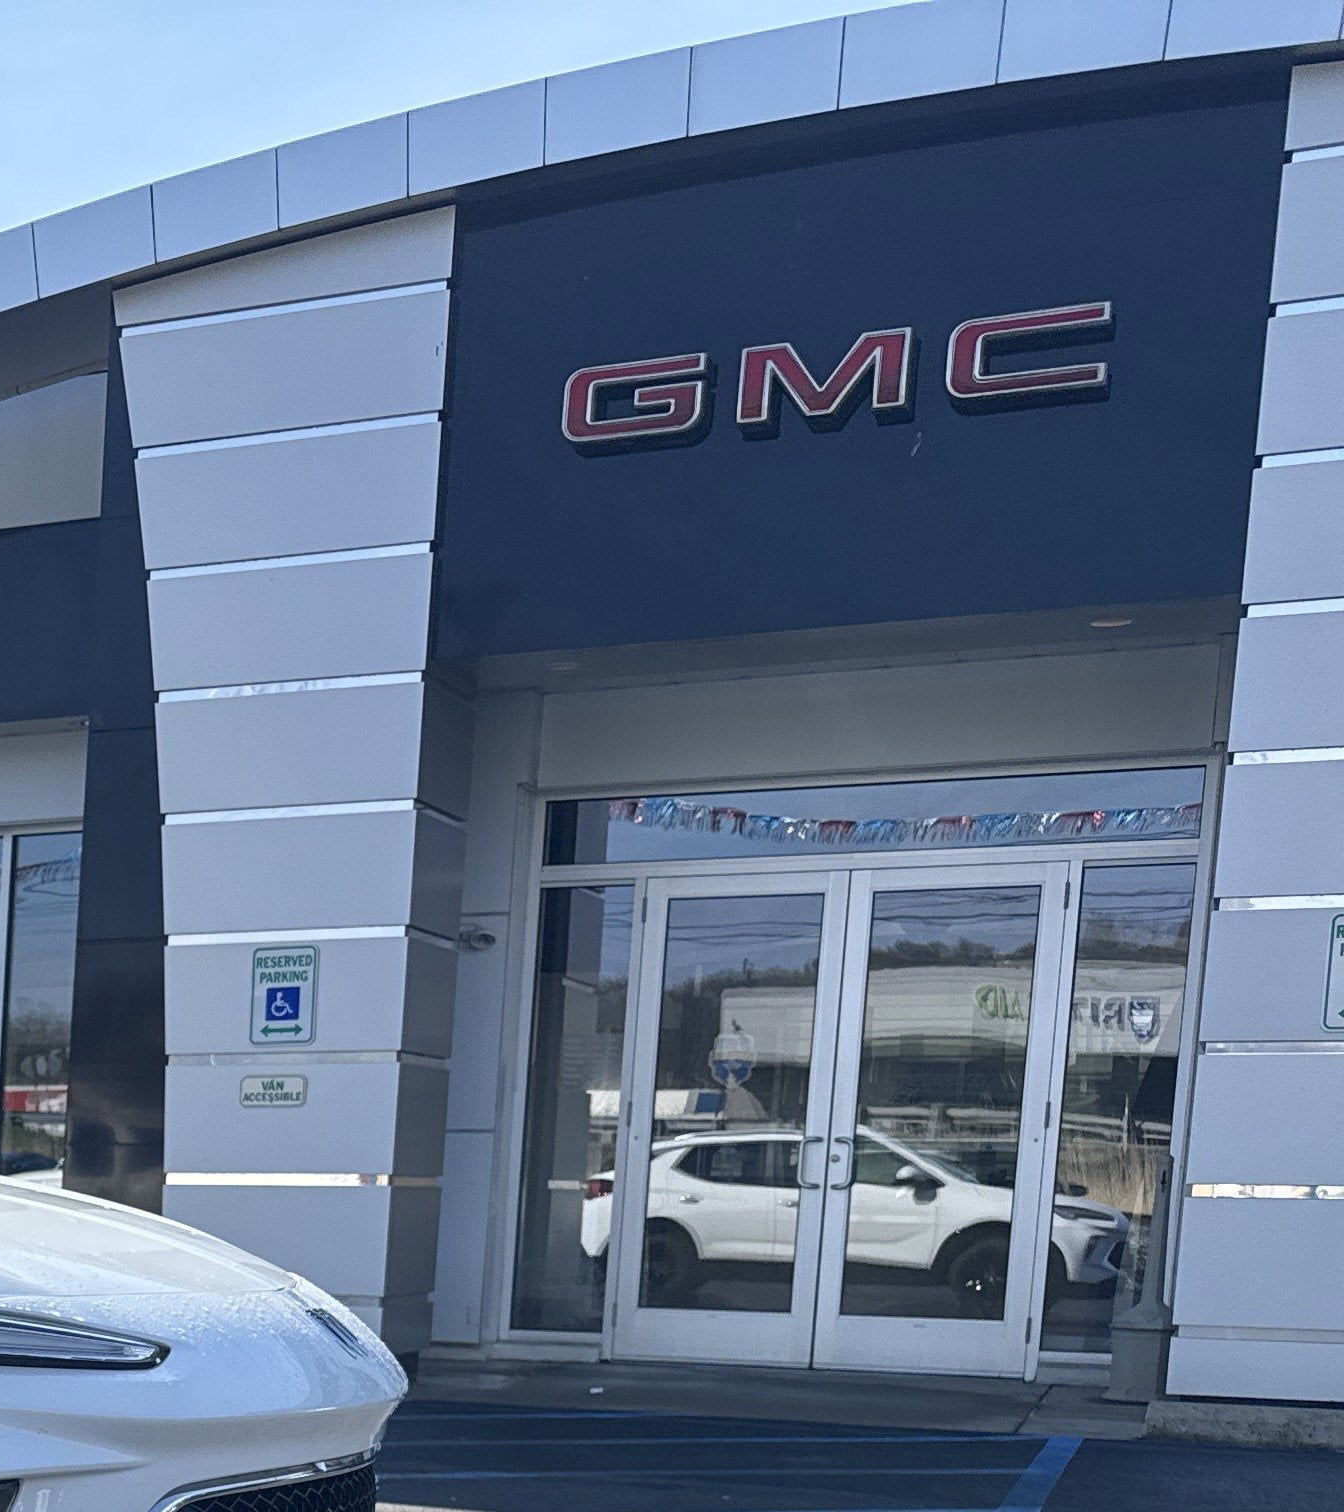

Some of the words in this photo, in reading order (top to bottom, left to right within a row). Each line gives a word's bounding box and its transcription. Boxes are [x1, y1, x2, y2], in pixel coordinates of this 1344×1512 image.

[561, 300, 1112, 443] GMC
[256, 954, 312, 969] RESERVED
[260, 970, 308, 984] PARKING
[261, 1080, 285, 1091] VAN
[242, 1092, 302, 1102] ACCESSIBLE
